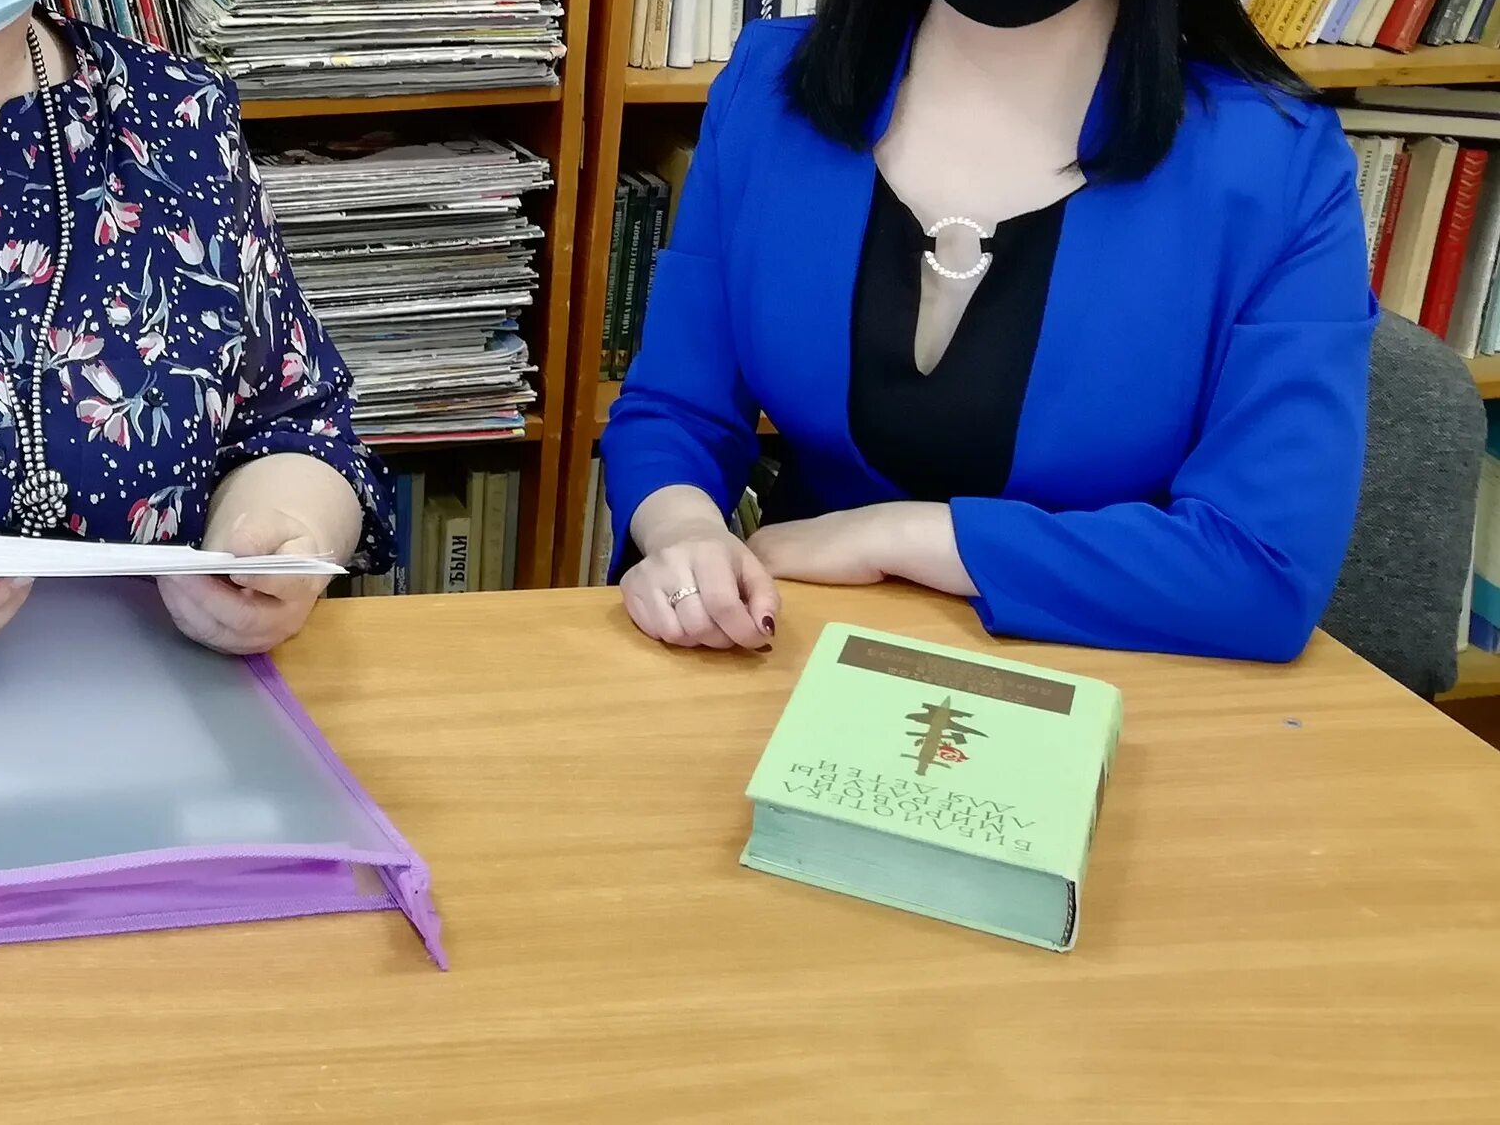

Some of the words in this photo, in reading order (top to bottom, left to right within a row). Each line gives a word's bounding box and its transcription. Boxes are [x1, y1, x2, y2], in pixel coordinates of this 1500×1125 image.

[450, 535, 468, 587] БЫЛИ
[818, 759, 939, 795] ДЕТЕЙ
[782, 780, 1032, 853] БИБЛИОТЕКА
[947, 790, 1016, 811] ДЛЯ
